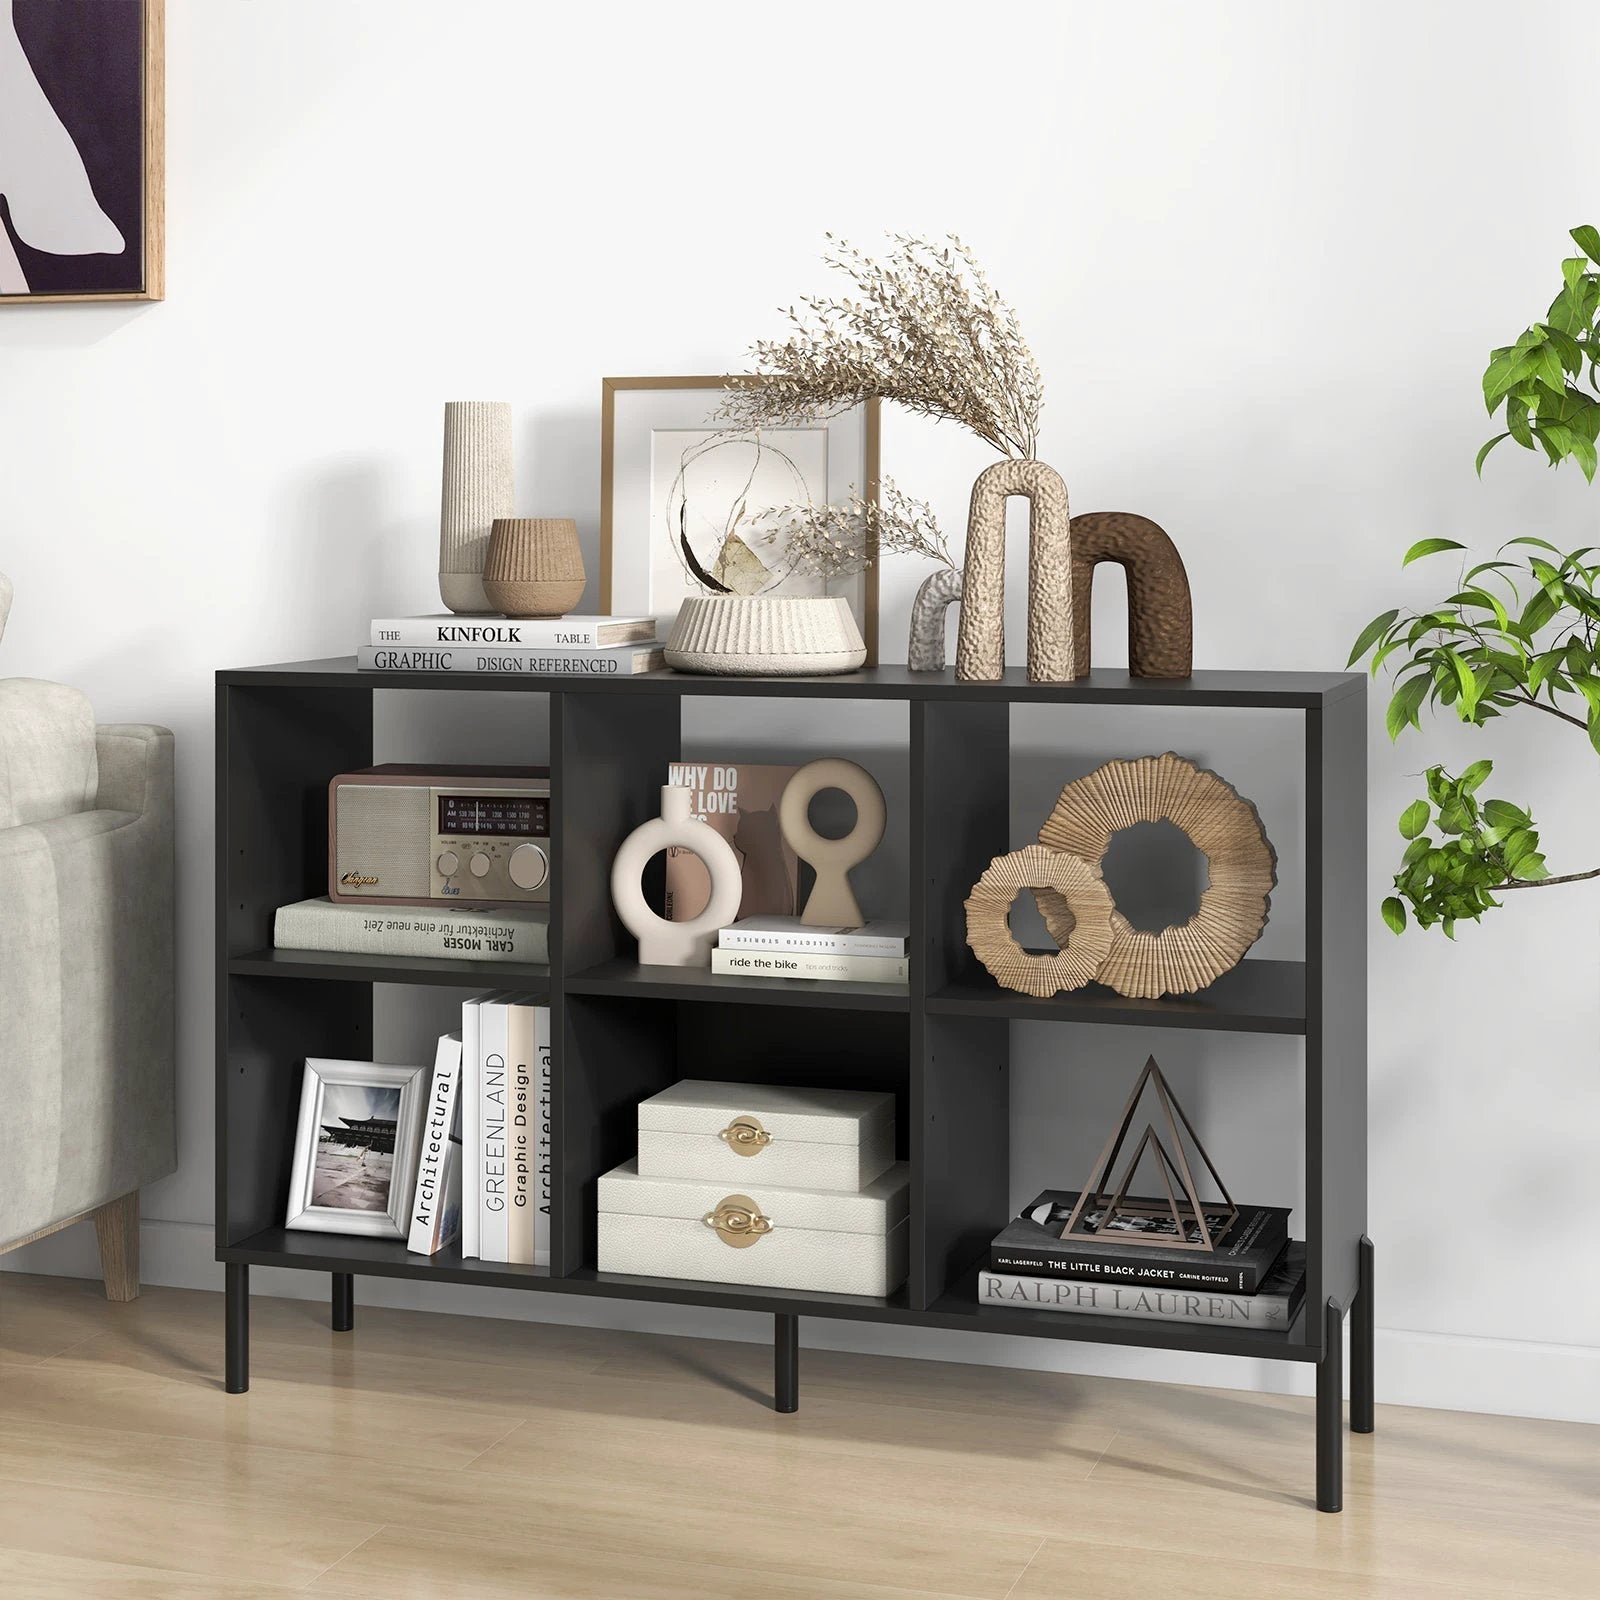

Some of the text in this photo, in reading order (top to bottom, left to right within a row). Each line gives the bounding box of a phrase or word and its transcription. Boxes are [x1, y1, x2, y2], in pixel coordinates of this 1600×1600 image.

[379, 626, 591, 644] THE KINFOLK TABLE
[374, 651, 618, 673] GRAPHIC DISIGN REFERENCED
[669, 766, 738, 791] WHY DO
[698, 791, 738, 814] LOVE
[363, 920, 515, 940] Architektur für eine neue Zeit
[736, 936, 836, 947] SELECTED STORIES
[443, 937, 514, 953] CARL MOSER
[729, 958, 751, 967] ride
[754, 959, 772, 969] the
[775, 960, 798, 970] bike
[806, 963, 817, 971] tips
[831, 964, 848, 972] tricks
[486, 1053, 505, 1212] GREENLAND
[514, 1063, 529, 1208] Graphic Design
[538, 1045, 550, 1215] Architectural
[415, 1072, 451, 1226] Architectural
[1013, 1259, 1043, 1267] LAGERFELD
[1048, 1261, 1067, 1270] THE
[1070, 1262, 1101, 1273] LITTLE
[1104, 1264, 1135, 1276] BLACK
[1138, 1267, 1175, 1279] JACKET
[1179, 1272, 1200, 1281] CARINE
[1201, 1274, 1229, 1283] ROITFELD
[985, 1277, 1252, 1321] RALPH LAUREN
